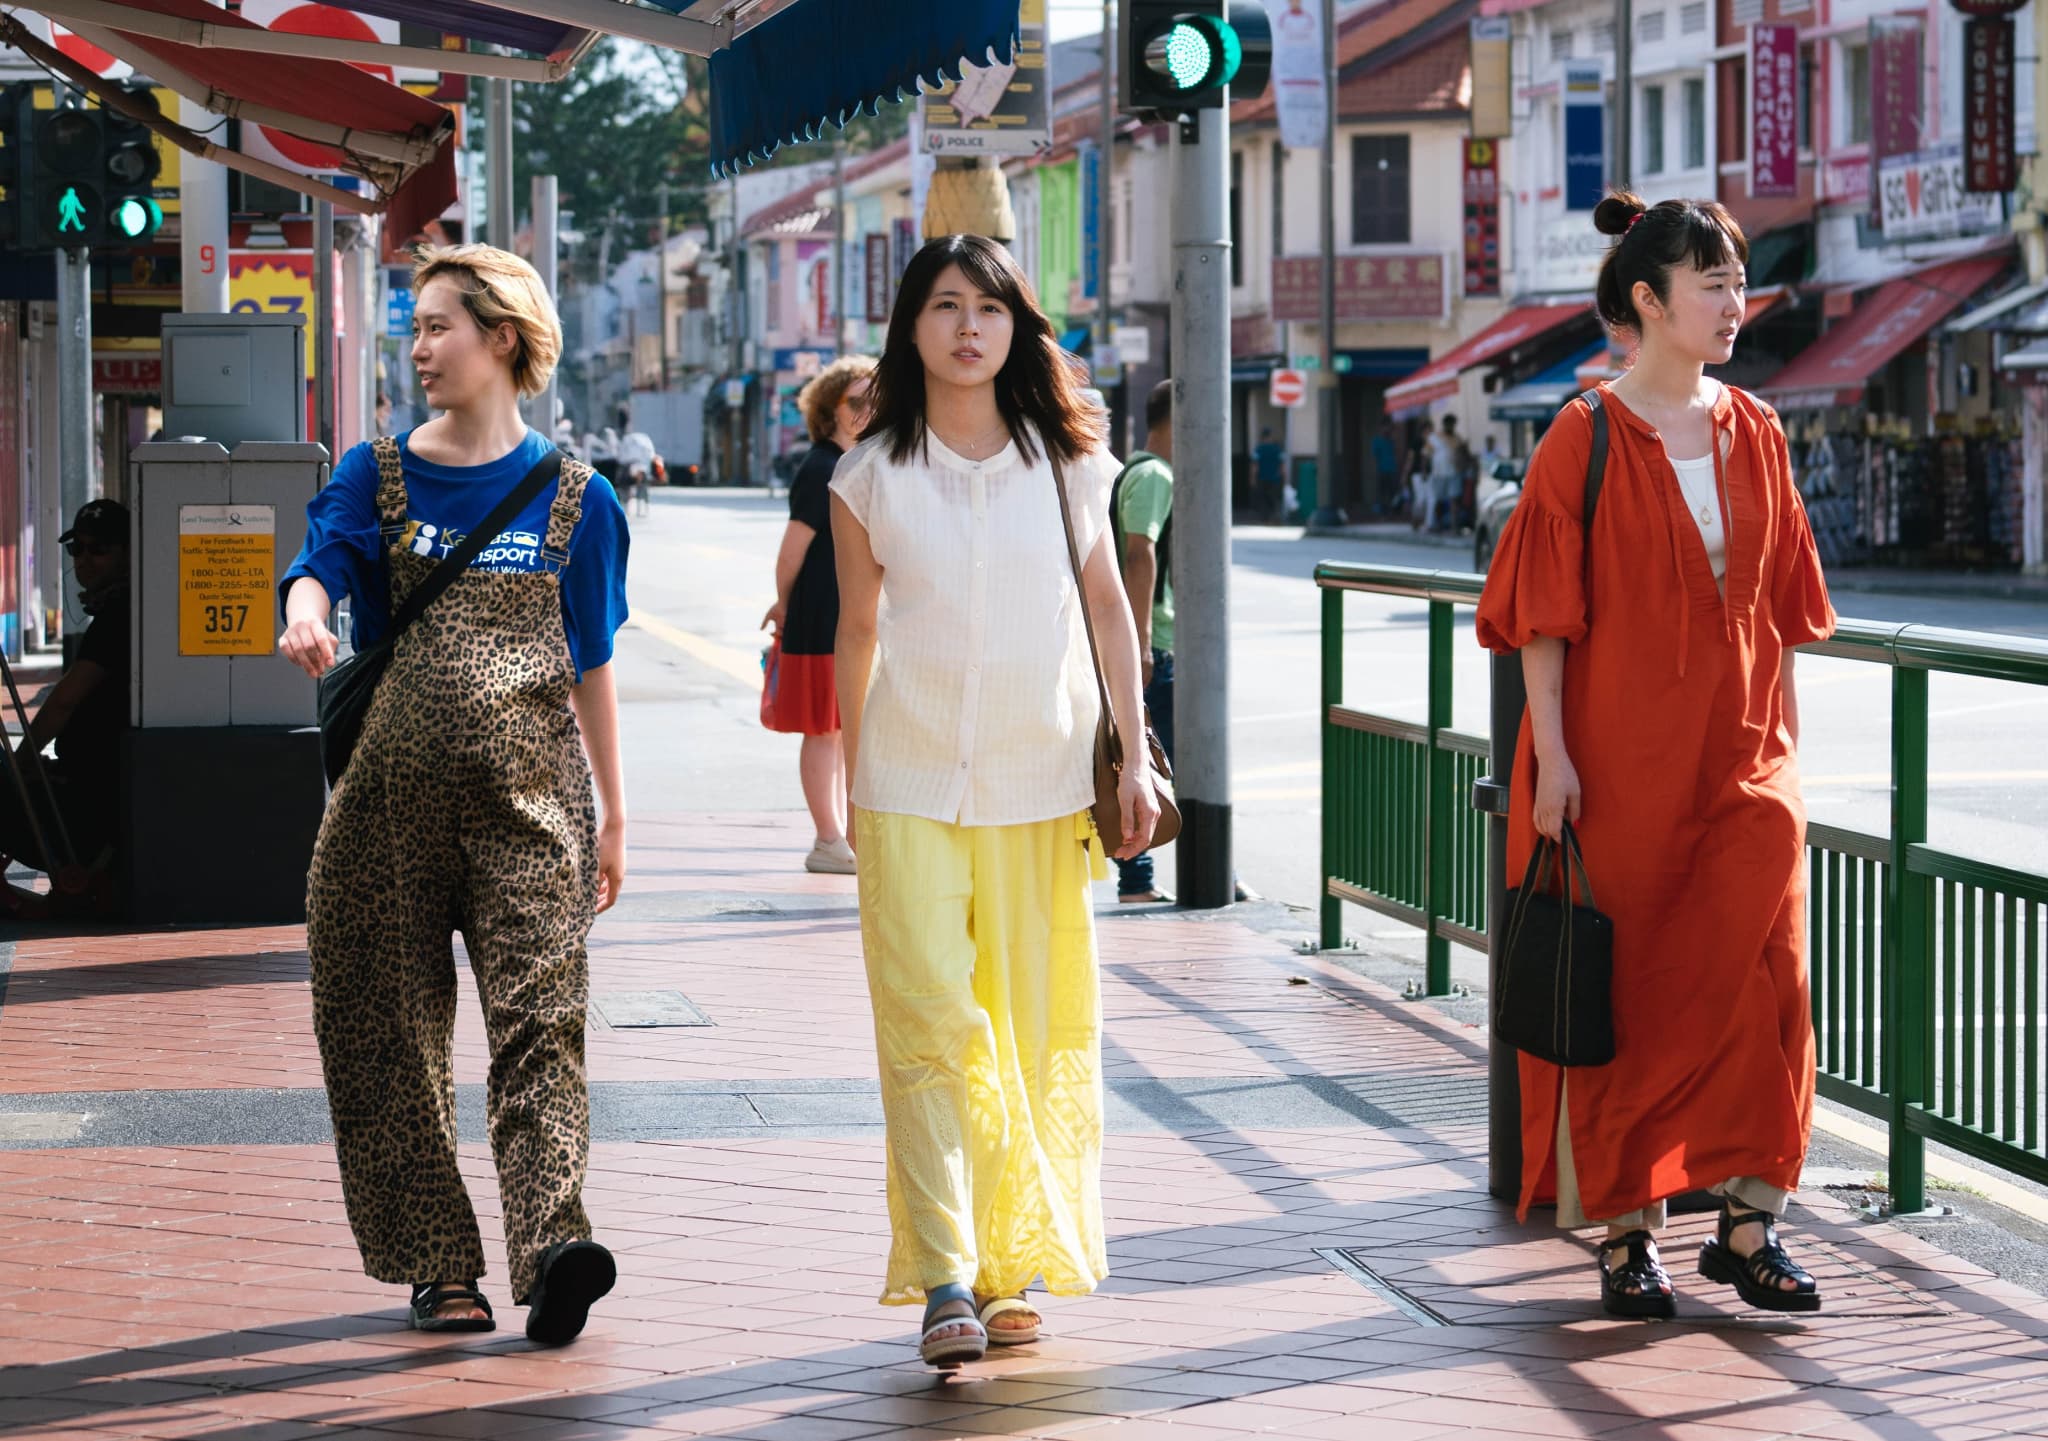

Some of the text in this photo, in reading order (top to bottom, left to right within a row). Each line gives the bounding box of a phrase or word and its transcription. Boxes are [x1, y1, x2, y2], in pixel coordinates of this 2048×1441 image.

[1756, 28, 1774, 183] NAKSHATRA
[1776, 54, 1792, 158] BEAUTY
[1973, 27, 1990, 185] COSTUME
[1993, 28, 2008, 183] JEWELLERY
[947, 136, 984, 147] POLICE
[200, 245, 216, 274] 9
[199, 515, 228, 525] Transport
[183, 546, 201, 554] Traffic
[204, 547, 225, 556] Signal
[201, 537, 212, 545] For
[214, 537, 245, 545] Feedback
[222, 593, 242, 602] Signal
[205, 605, 249, 632] 357
